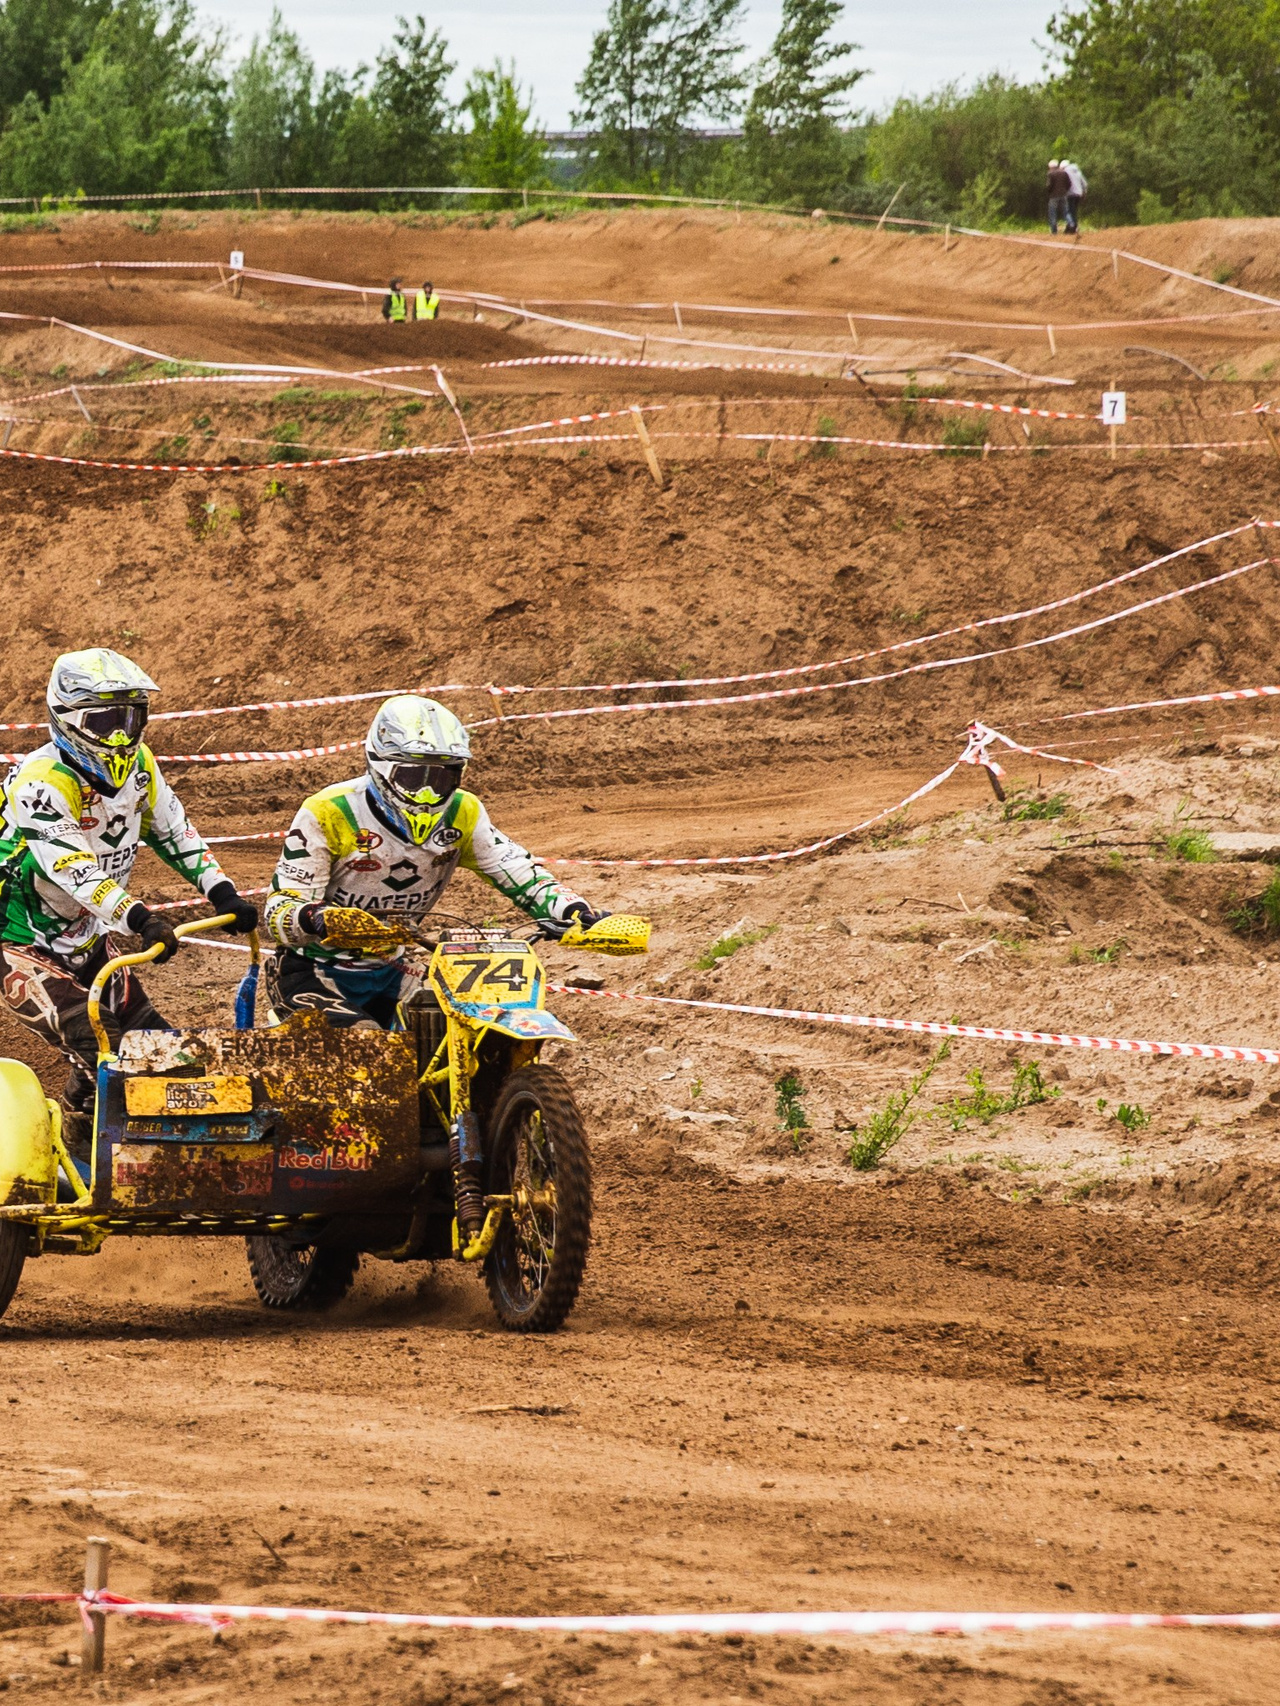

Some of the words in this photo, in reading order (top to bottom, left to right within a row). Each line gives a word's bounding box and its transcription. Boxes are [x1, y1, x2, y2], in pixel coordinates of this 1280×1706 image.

[1109, 400, 1118, 417] 7
[453, 958, 528, 993] 74
[278, 1145, 329, 1170] Red
[330, 1146, 376, 1172] Bul
